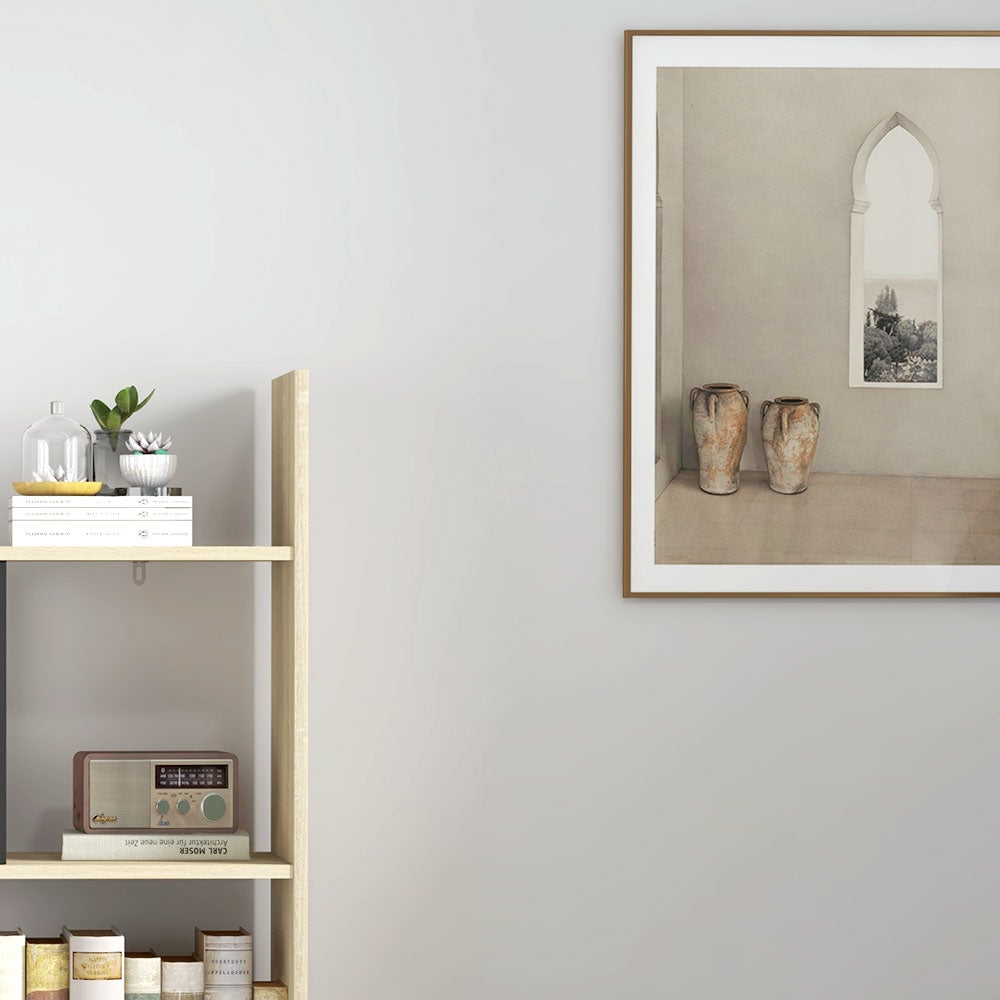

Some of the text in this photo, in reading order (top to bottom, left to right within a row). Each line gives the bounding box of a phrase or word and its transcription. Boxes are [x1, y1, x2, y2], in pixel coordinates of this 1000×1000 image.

[125, 839, 139, 847] Zeit
[176, 839, 187, 847] für
[188, 839, 228, 847] Architektur
[179, 847, 228, 855] CARL MOSER
